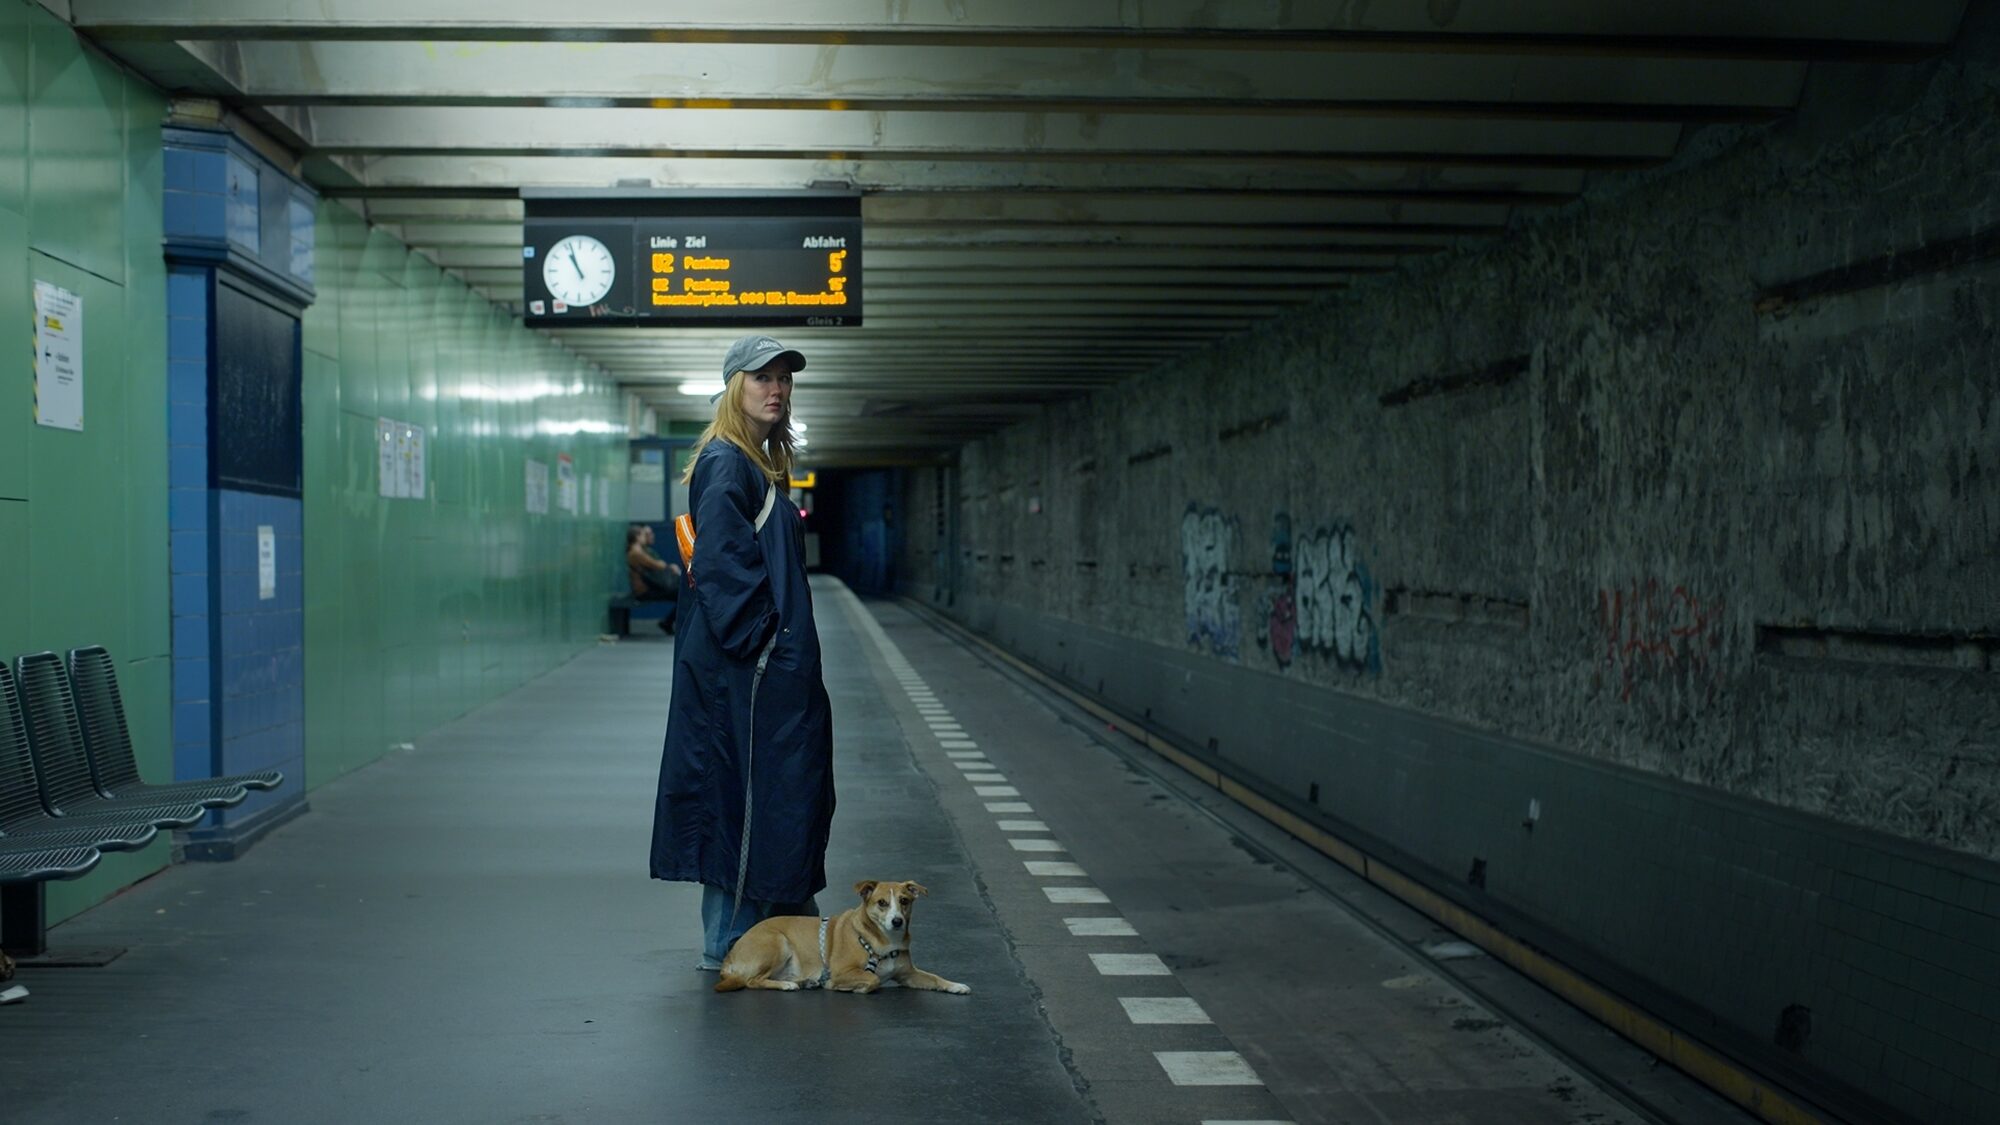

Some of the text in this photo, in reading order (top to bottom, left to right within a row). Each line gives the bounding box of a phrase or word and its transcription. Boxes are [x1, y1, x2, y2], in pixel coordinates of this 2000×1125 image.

[650, 236, 846, 248] Linie Ziel Abfahrt
[652, 253, 674, 273] U2
[806, 316, 843, 326] Gleis 2
